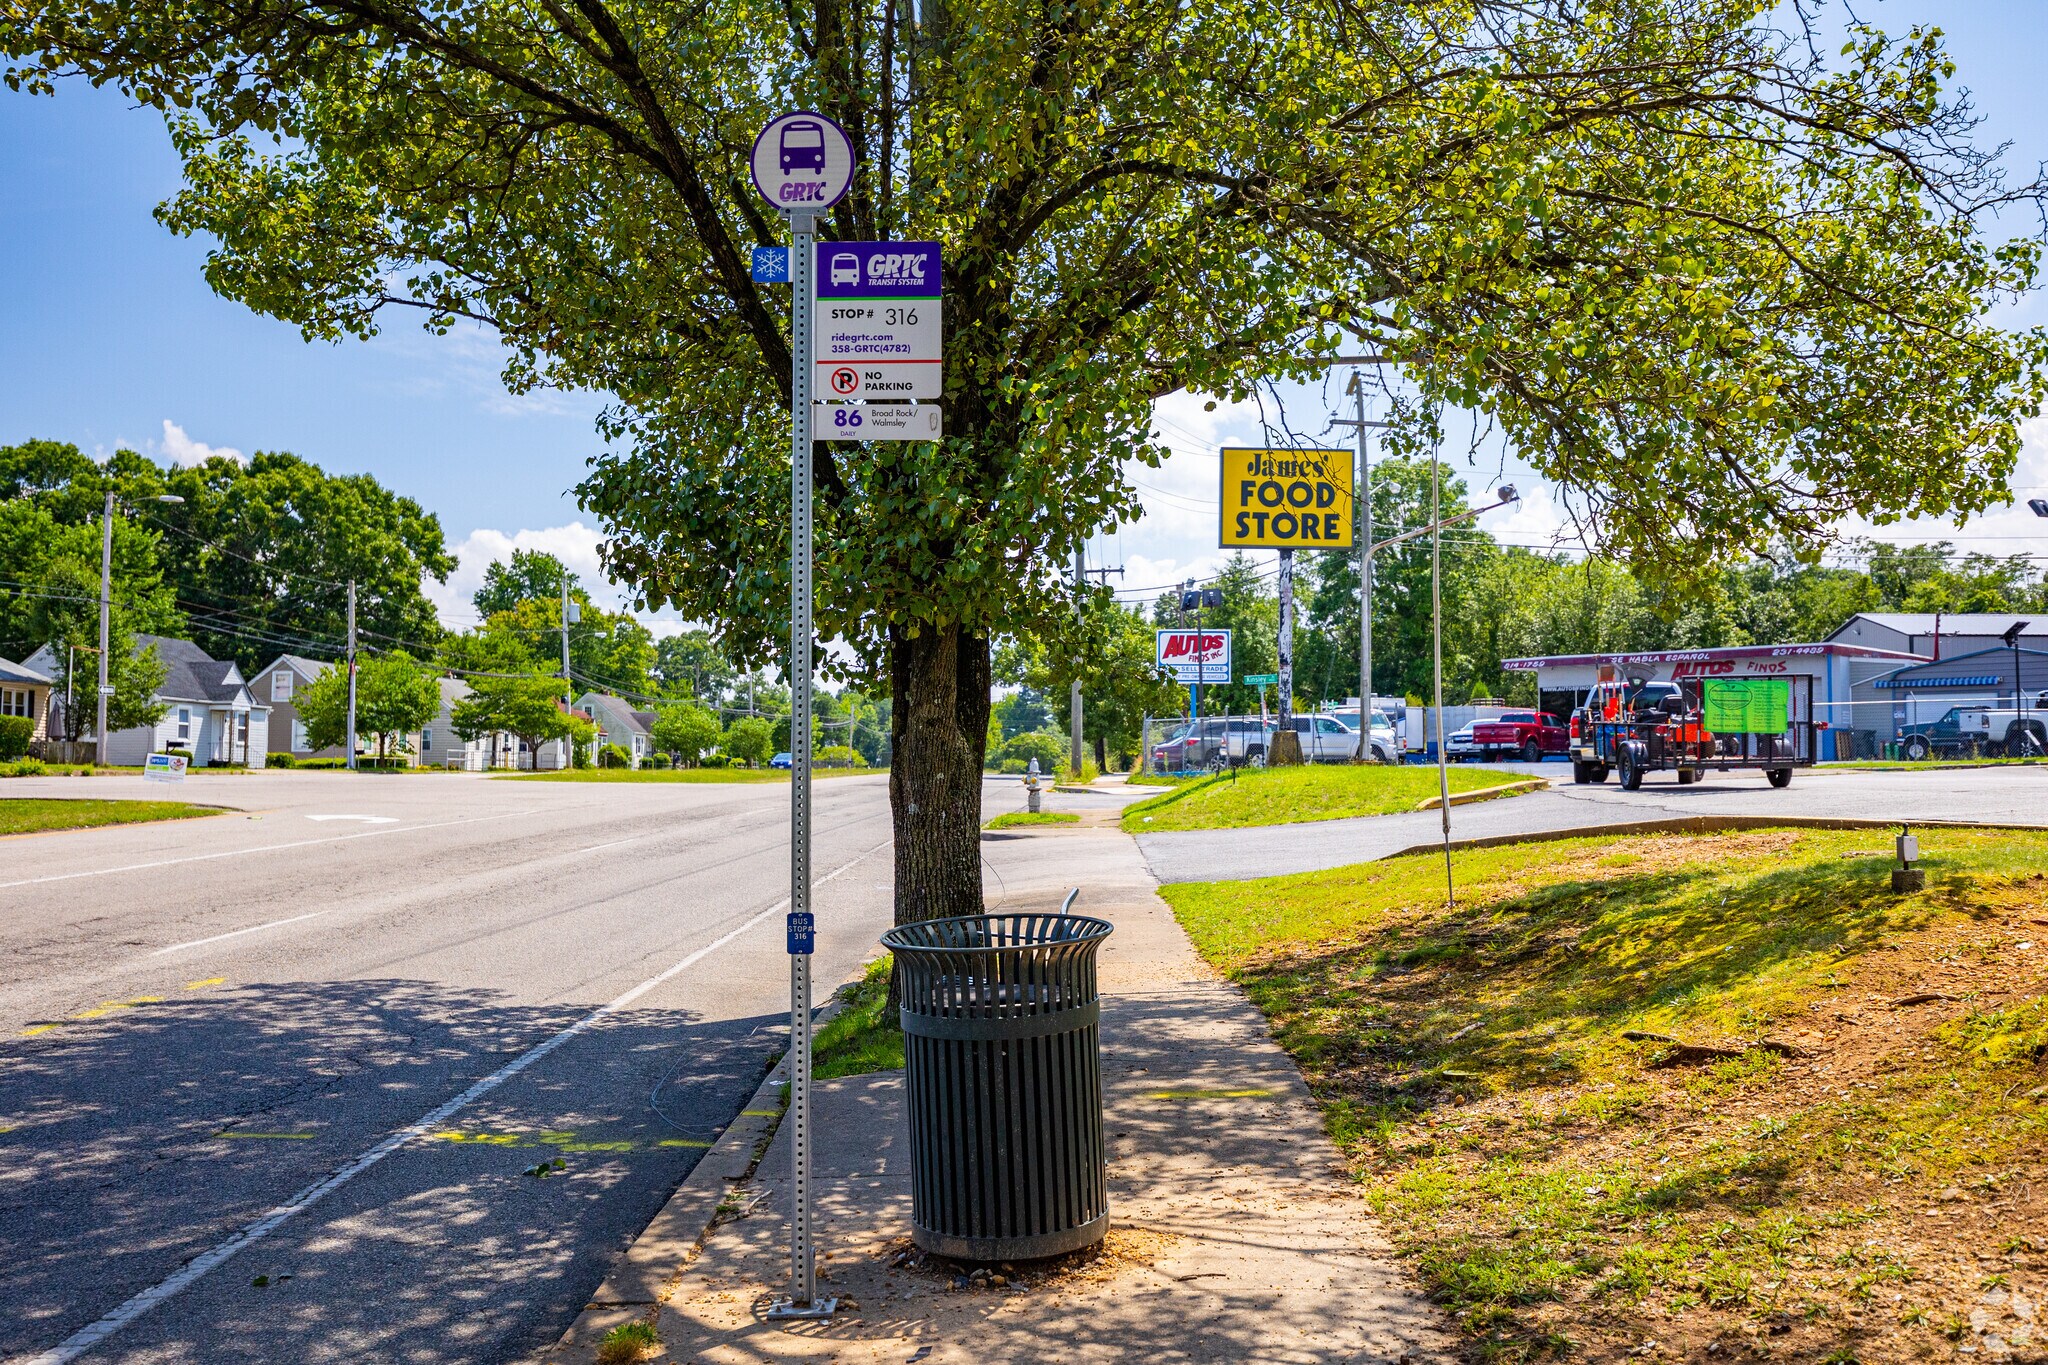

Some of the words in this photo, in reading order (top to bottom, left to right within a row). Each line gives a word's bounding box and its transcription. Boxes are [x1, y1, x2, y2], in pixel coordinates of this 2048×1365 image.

[779, 181, 826, 202] GRTC
[867, 253, 927, 278] GRTC
[885, 308, 918, 326] 316
[831, 333, 893, 343] ridegrtc.com
[831, 344, 911, 354] 358-GRTC(4782)
[865, 372, 882, 380] NO
[865, 382, 913, 391] PARKING
[834, 409, 863, 427] 86
[871, 409, 894, 417] Broad
[896, 408, 919, 418] Rock/
[871, 418, 907, 429] Walmsley
[1240, 480, 1336, 508] FOOD
[1235, 511, 1341, 540] STORE
[1162, 635, 1225, 659] AUTOS
[1628, 655, 1661, 664] HABLA
[1670, 660, 1736, 681] AUTOS
[1747, 660, 1788, 674] FINOS
